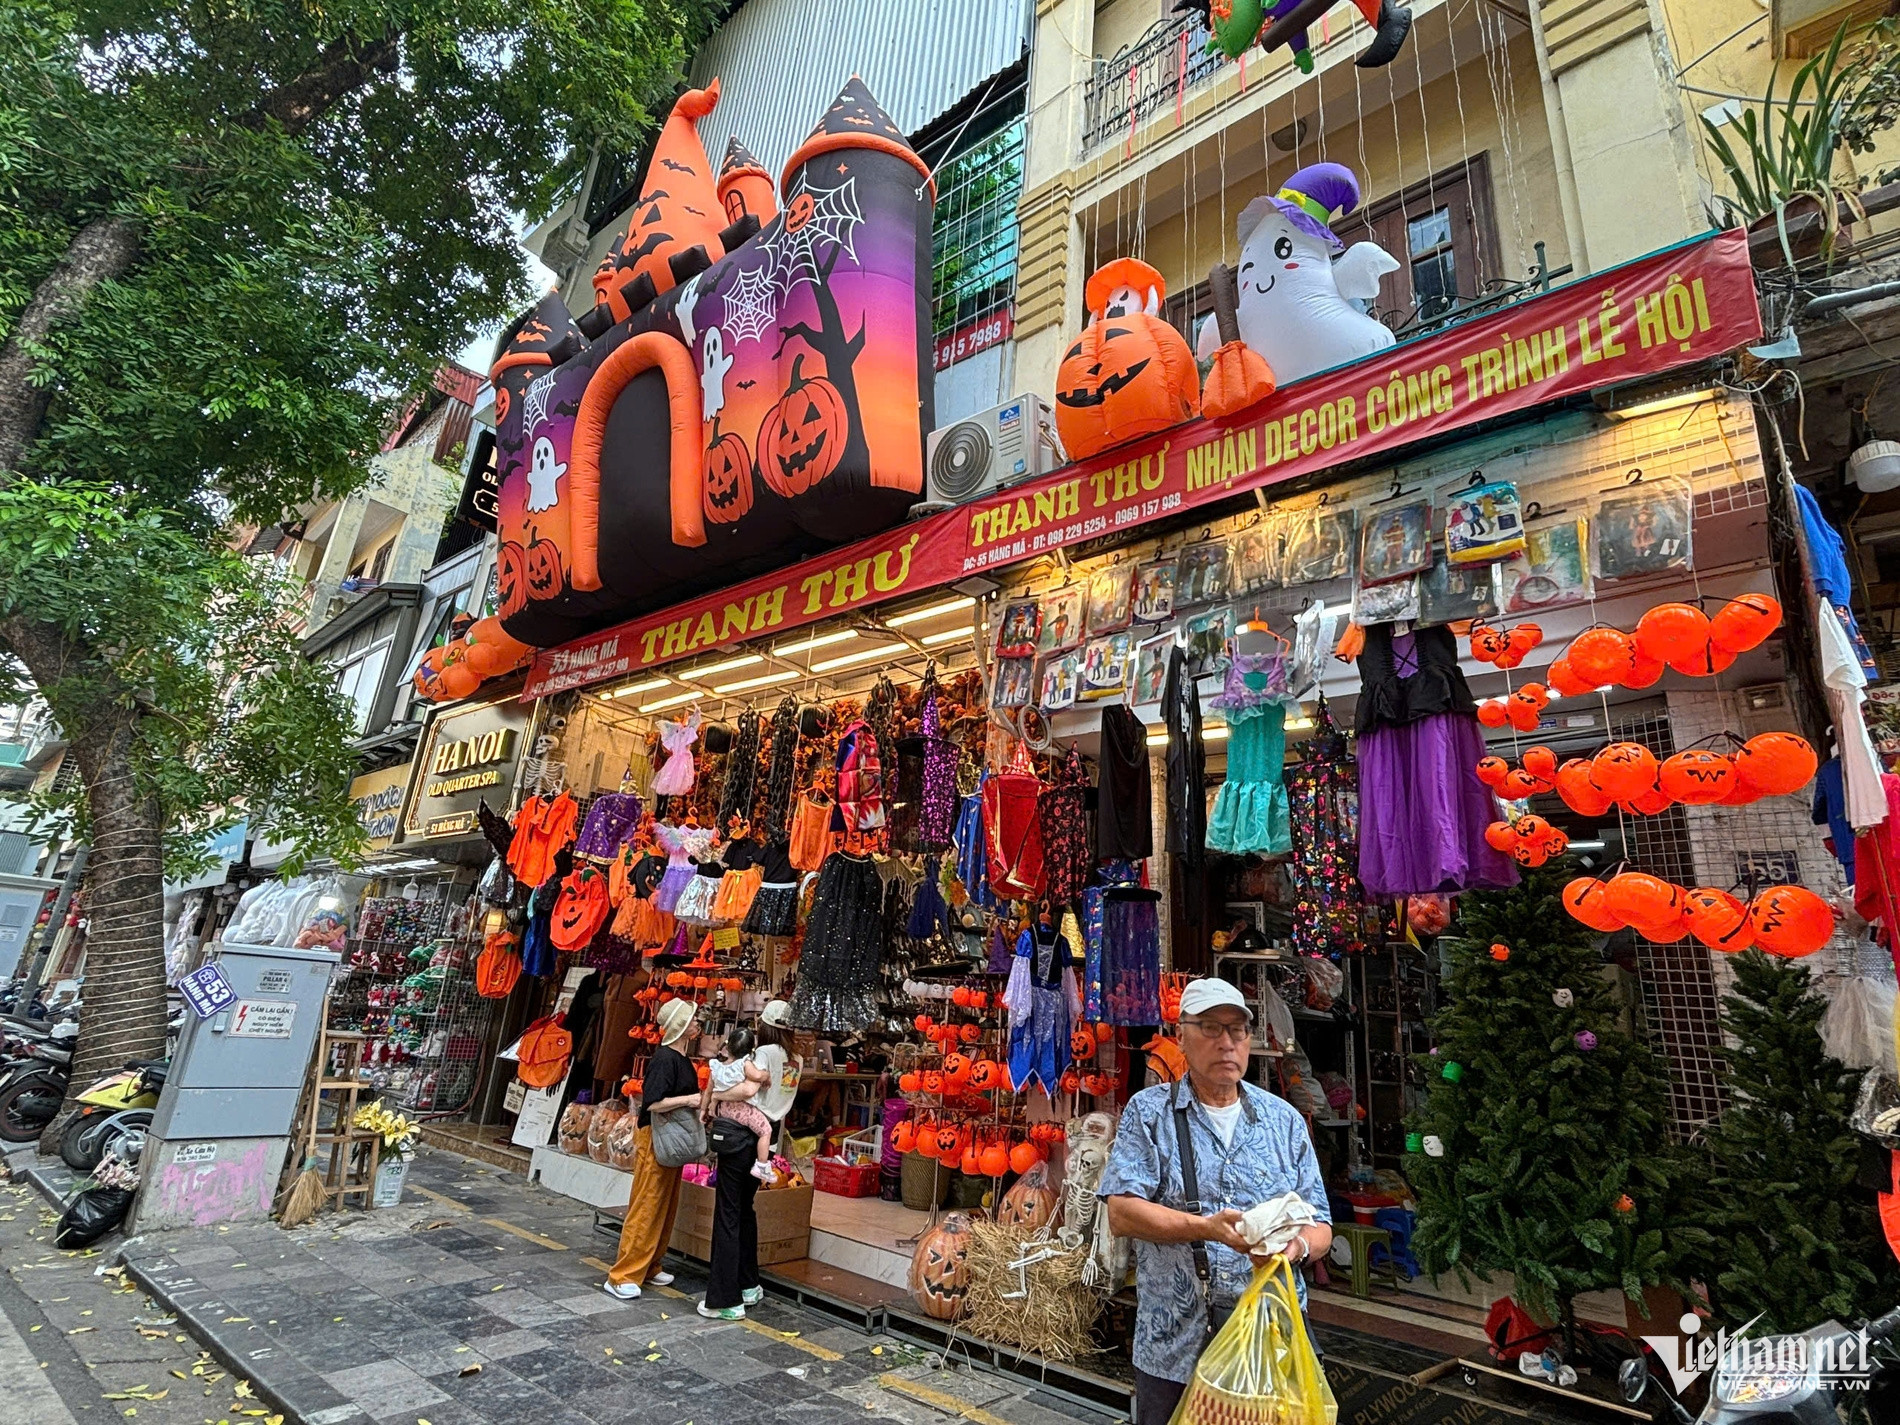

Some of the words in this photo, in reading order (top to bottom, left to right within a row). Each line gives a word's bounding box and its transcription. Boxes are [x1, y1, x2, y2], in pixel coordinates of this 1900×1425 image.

[969, 320, 1002, 351] 7988
[1187, 428, 1257, 492] NHẬN
[1265, 396, 1358, 467] DECOR
[1366, 369, 1454, 434] CÔNG
[1461, 332, 1570, 402] TRÌNH
[1578, 288, 1626, 365] LỄ
[1634, 273, 1712, 353] HỘI
[971, 479, 1082, 547] THANH
[1090, 441, 1171, 508] THƯ
[977, 554, 988, 567] 55
[989, 544, 1011, 563] HÀNG
[1012, 538, 1026, 557] MÃ
[1047, 528, 1064, 546] 098
[1065, 523, 1082, 540] 229
[1084, 516, 1107, 535] 5254
[1115, 505, 1139, 526] 0969
[1142, 498, 1159, 517] 157
[1161, 492, 1182, 512] 988
[641, 585, 788, 664] THANH
[800, 533, 920, 615] THƯ
[549, 649, 570, 675] 53
[569, 646, 600, 670] HÀNG
[599, 635, 620, 660] MÃ
[427, 783, 443, 798] OLD
[442, 775, 480, 797] QUARTER
[479, 770, 498, 787] SPA
[205, 978, 231, 1004] 53
